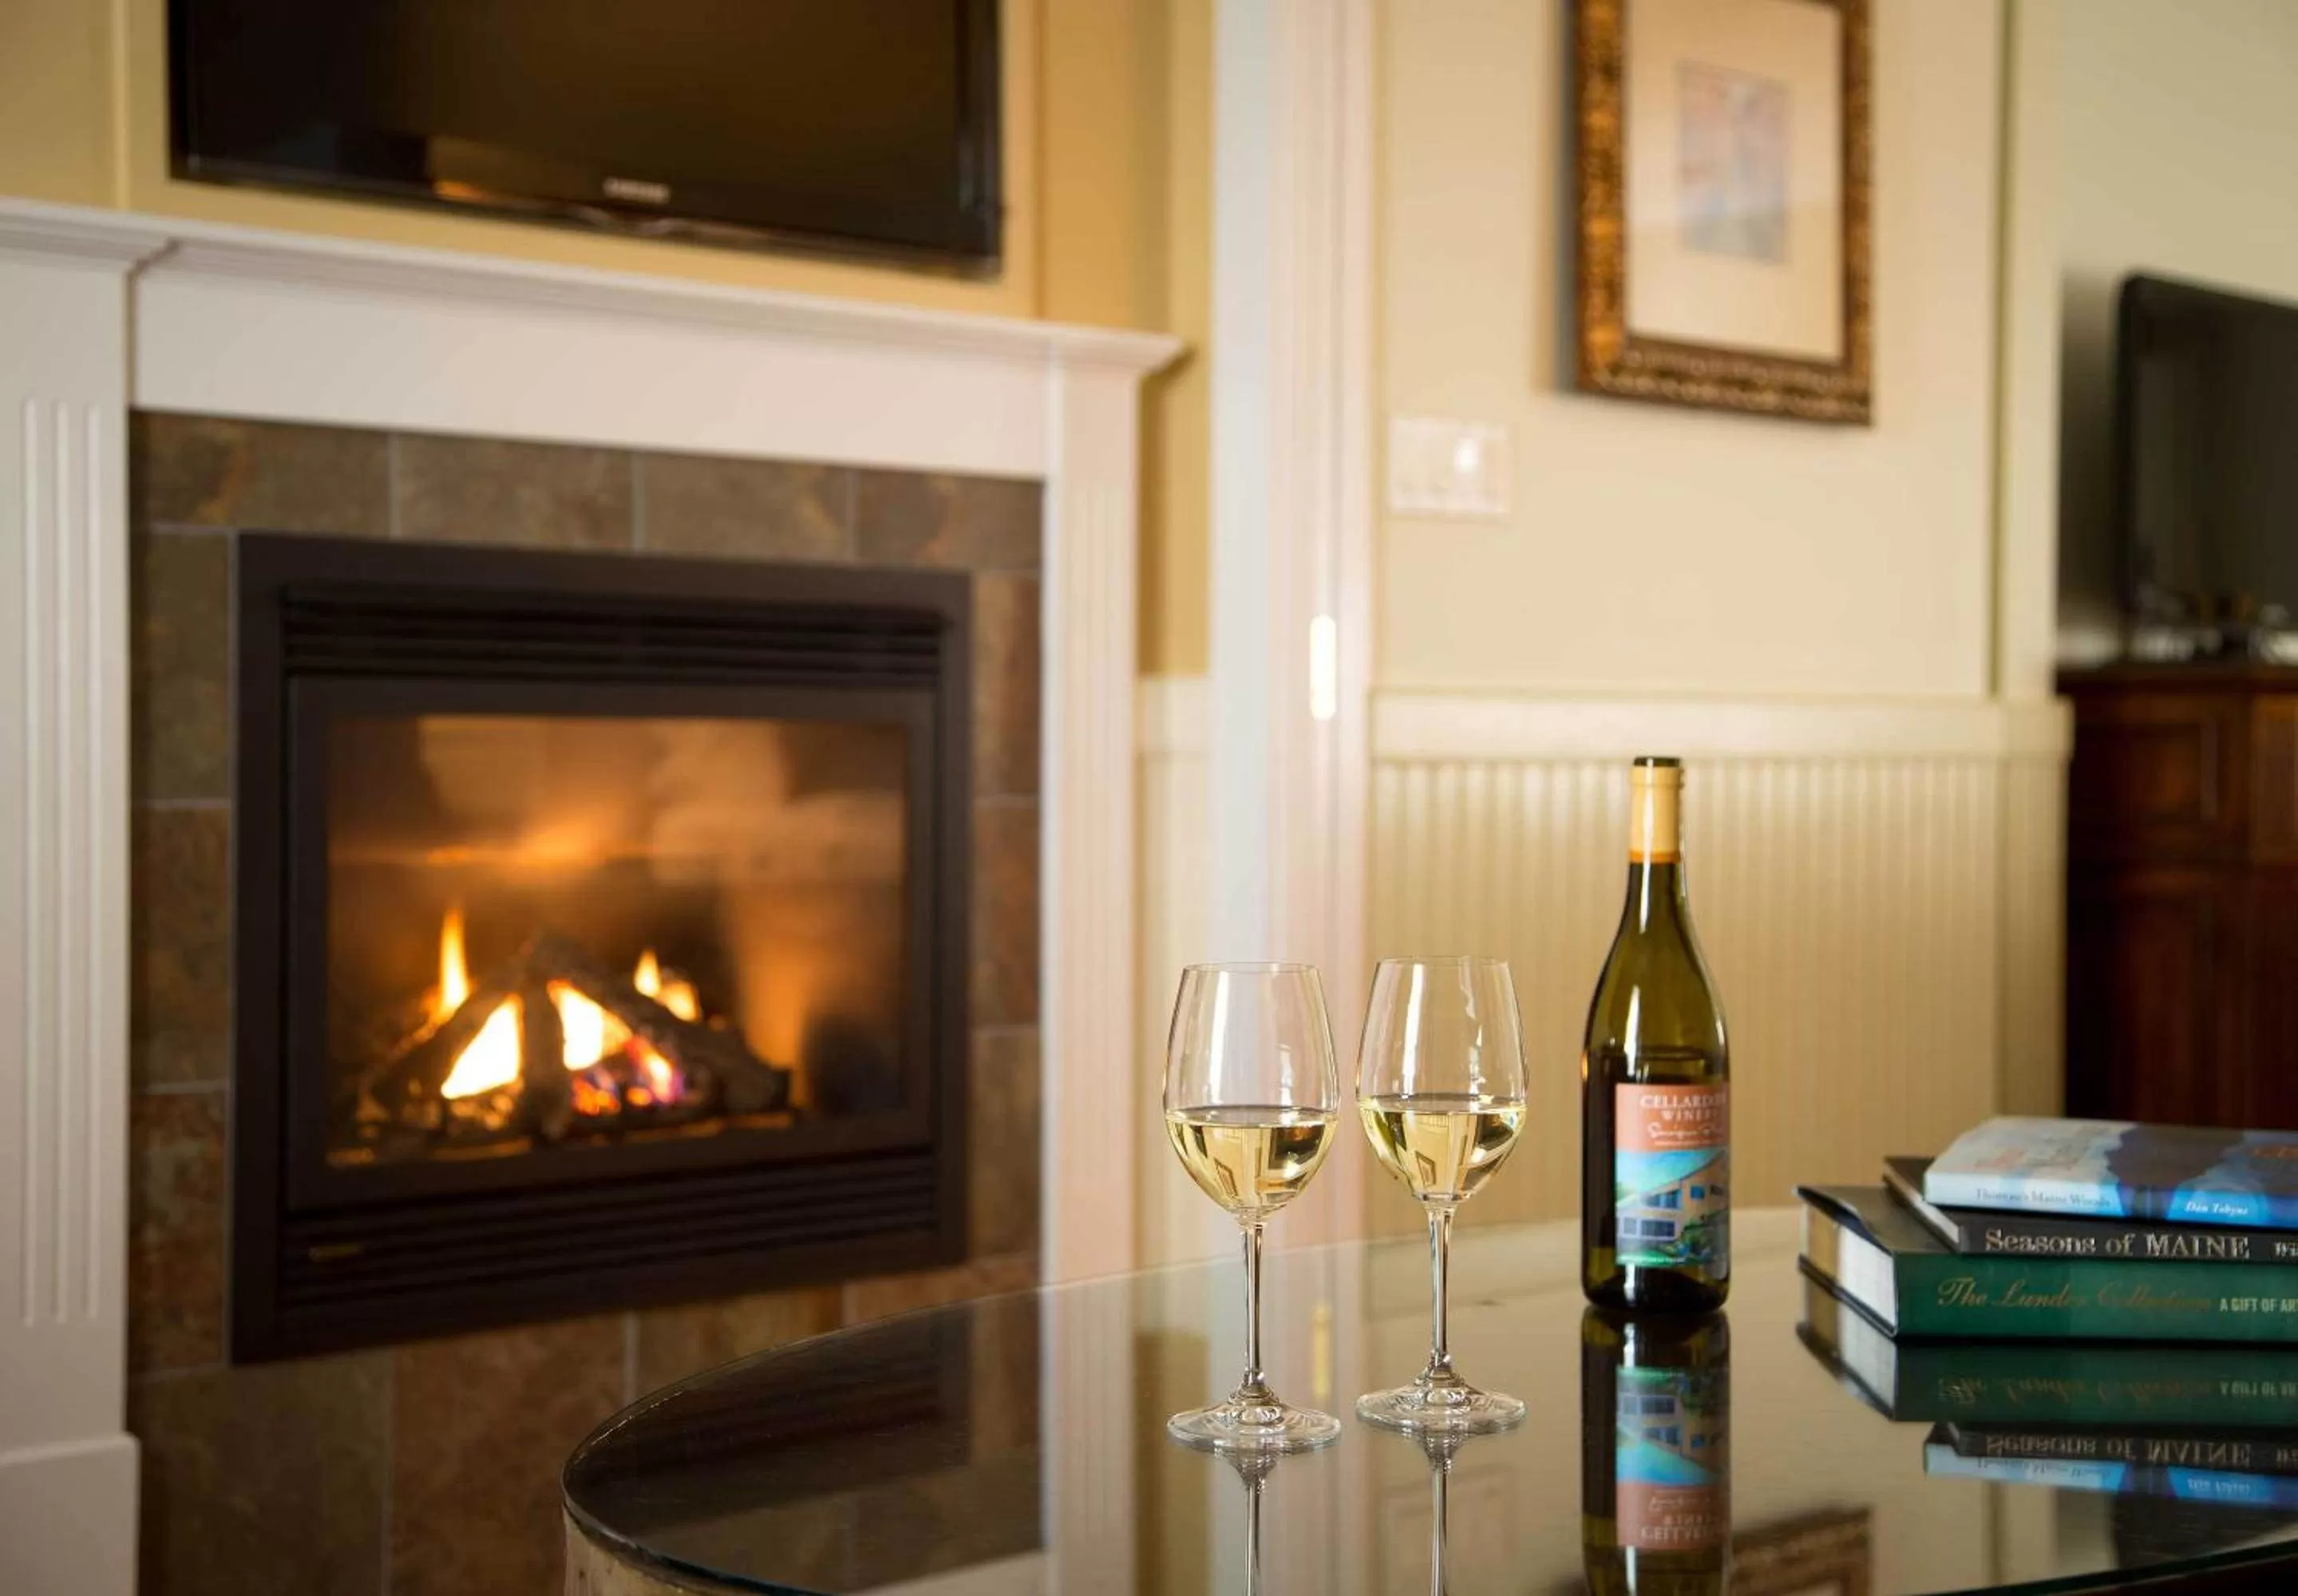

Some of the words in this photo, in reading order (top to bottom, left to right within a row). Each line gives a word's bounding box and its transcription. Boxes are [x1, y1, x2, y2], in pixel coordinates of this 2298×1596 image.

[1662, 1108, 1719, 1121] WINE
[2185, 1201, 2209, 1214] Dan
[1985, 1228, 2097, 1255] Seasons
[2105, 1233, 2136, 1256] of
[2145, 1234, 2250, 1260] MAINE
[1937, 1277, 1988, 1307] The
[2219, 1298, 2229, 1312] A
[2230, 1297, 2258, 1313] GIFT
[2260, 1298, 2276, 1314] OF
